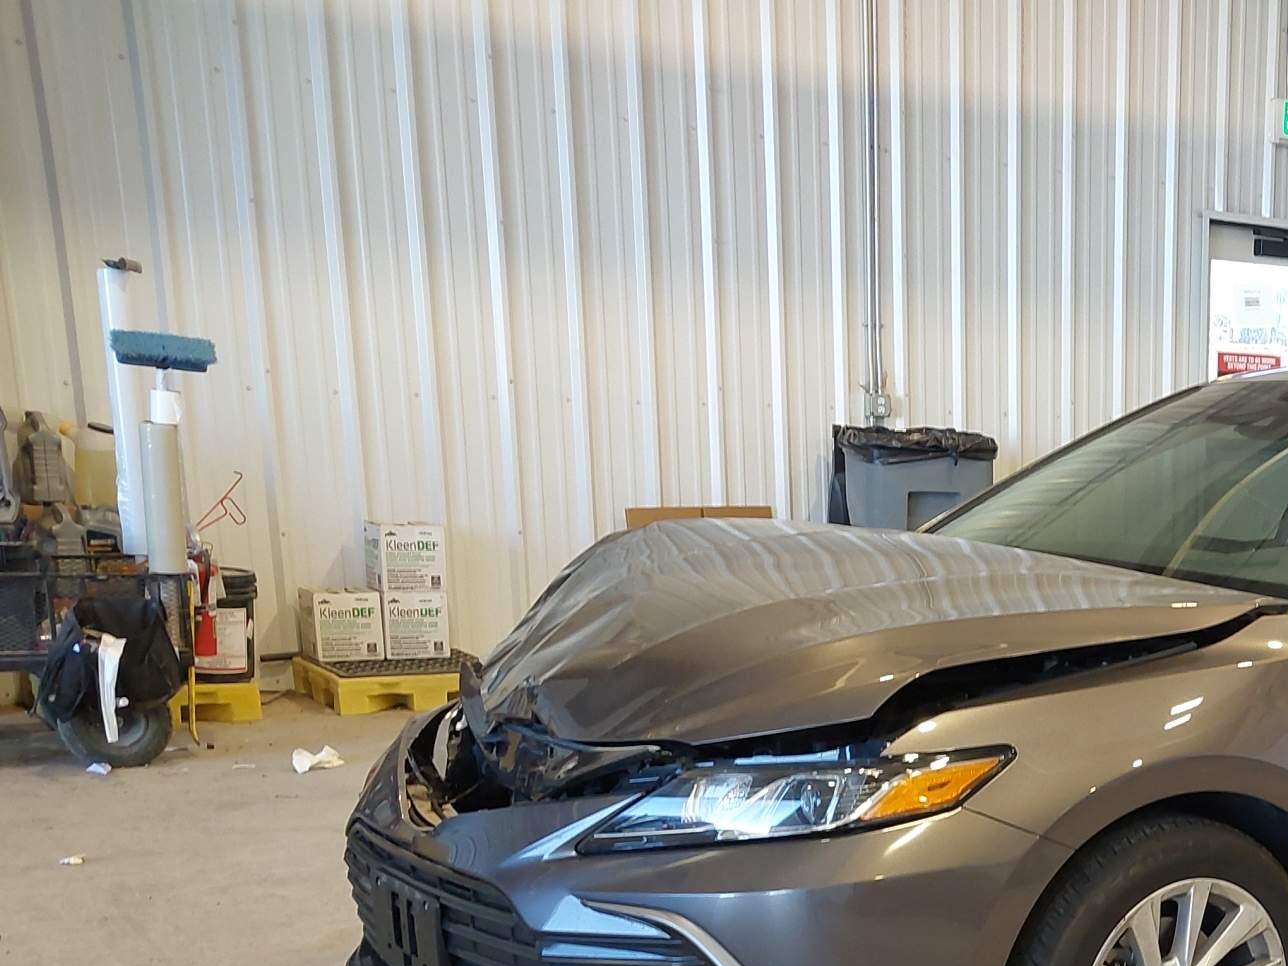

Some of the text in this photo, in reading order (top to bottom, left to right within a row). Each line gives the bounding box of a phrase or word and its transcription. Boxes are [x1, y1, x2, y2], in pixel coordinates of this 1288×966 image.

[385, 539, 439, 551] KleenDEF
[319, 607, 375, 618] KleenDEF
[389, 607, 442, 618] KleenDEF
